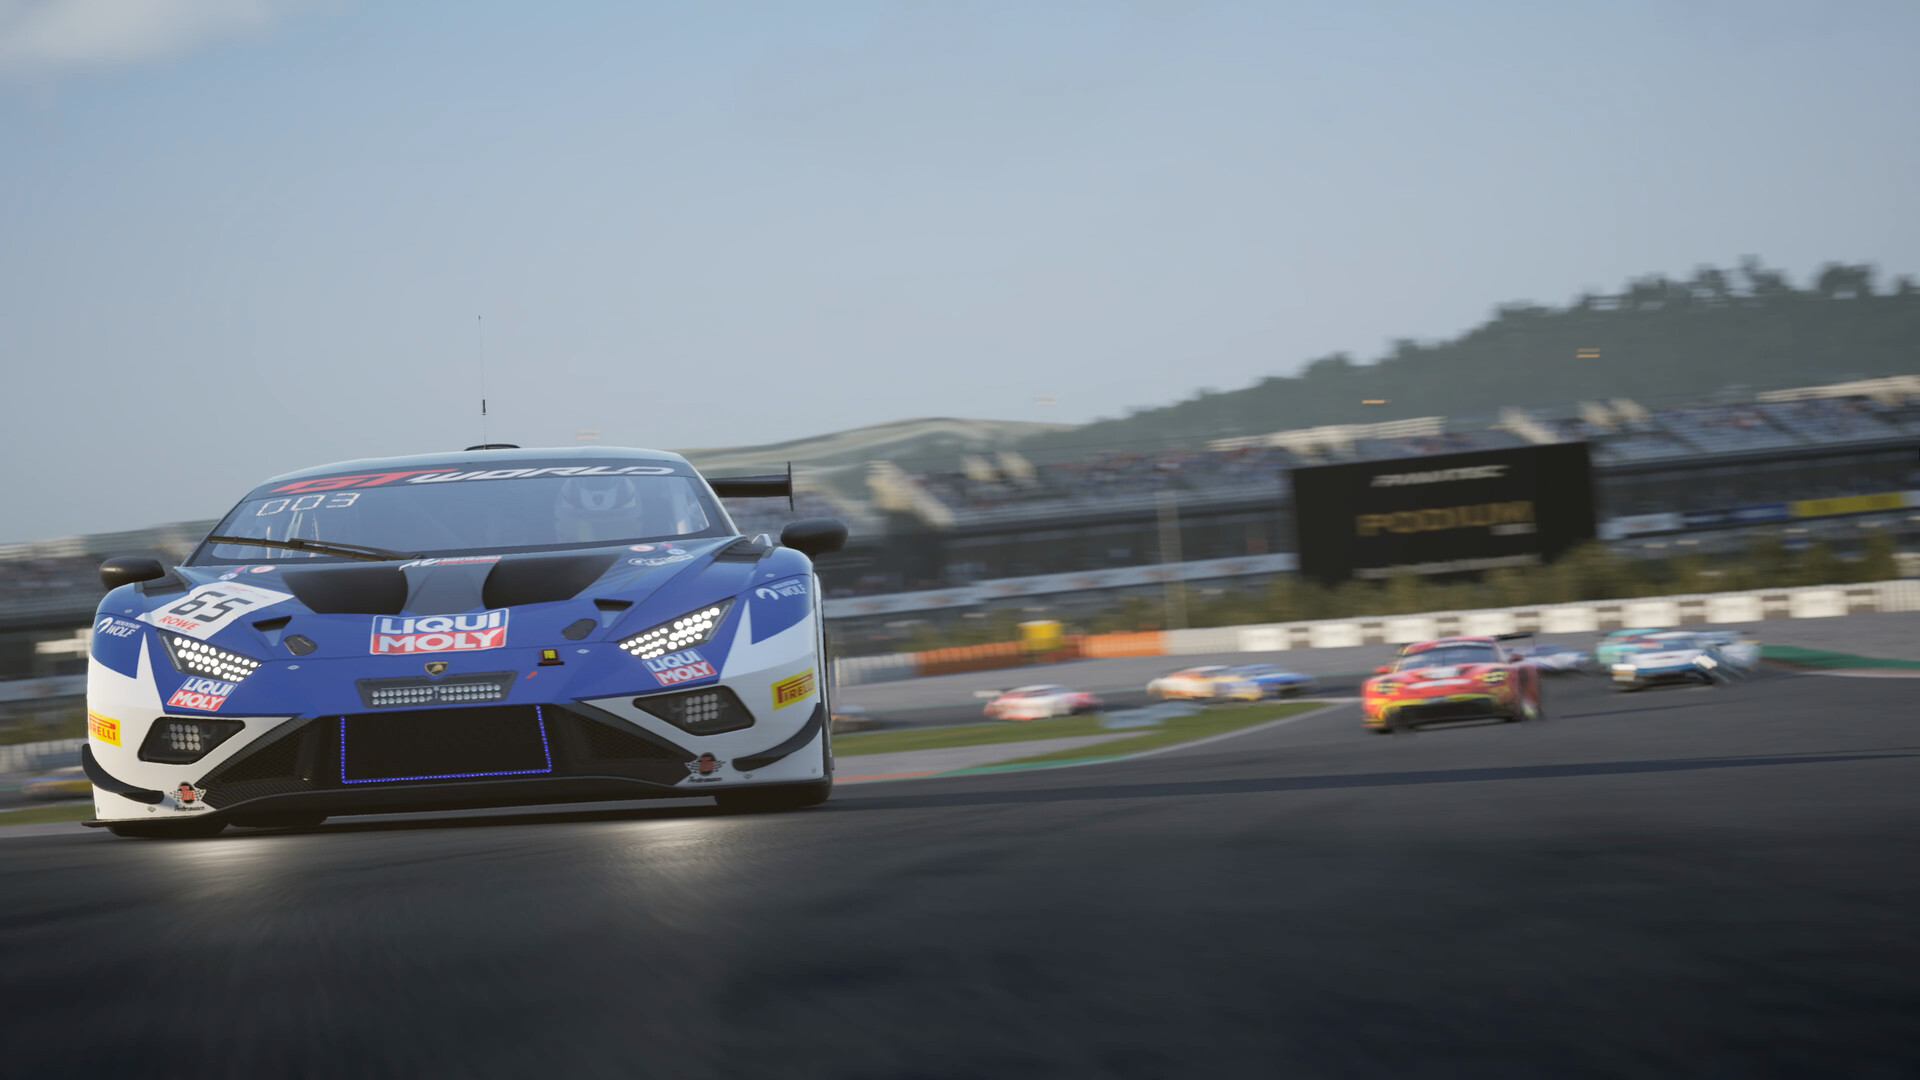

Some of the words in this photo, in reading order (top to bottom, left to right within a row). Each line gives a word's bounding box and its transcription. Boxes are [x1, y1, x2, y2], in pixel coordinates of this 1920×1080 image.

[406, 465, 675, 484] WORLD
[255, 492, 360, 517] 003
[1355, 500, 1535, 536] PODIUM
[168, 591, 253, 623] 65
[106, 623, 136, 639] WOLF
[158, 615, 201, 631] ROWE
[380, 611, 501, 634] LIQUI
[378, 628, 503, 652] MOLY
[647, 650, 702, 672] LIQUI
[656, 661, 712, 685] MOLY
[182, 679, 234, 697] LIQUI
[776, 672, 815, 704] PIRELLI
[170, 691, 225, 710] MOLY
